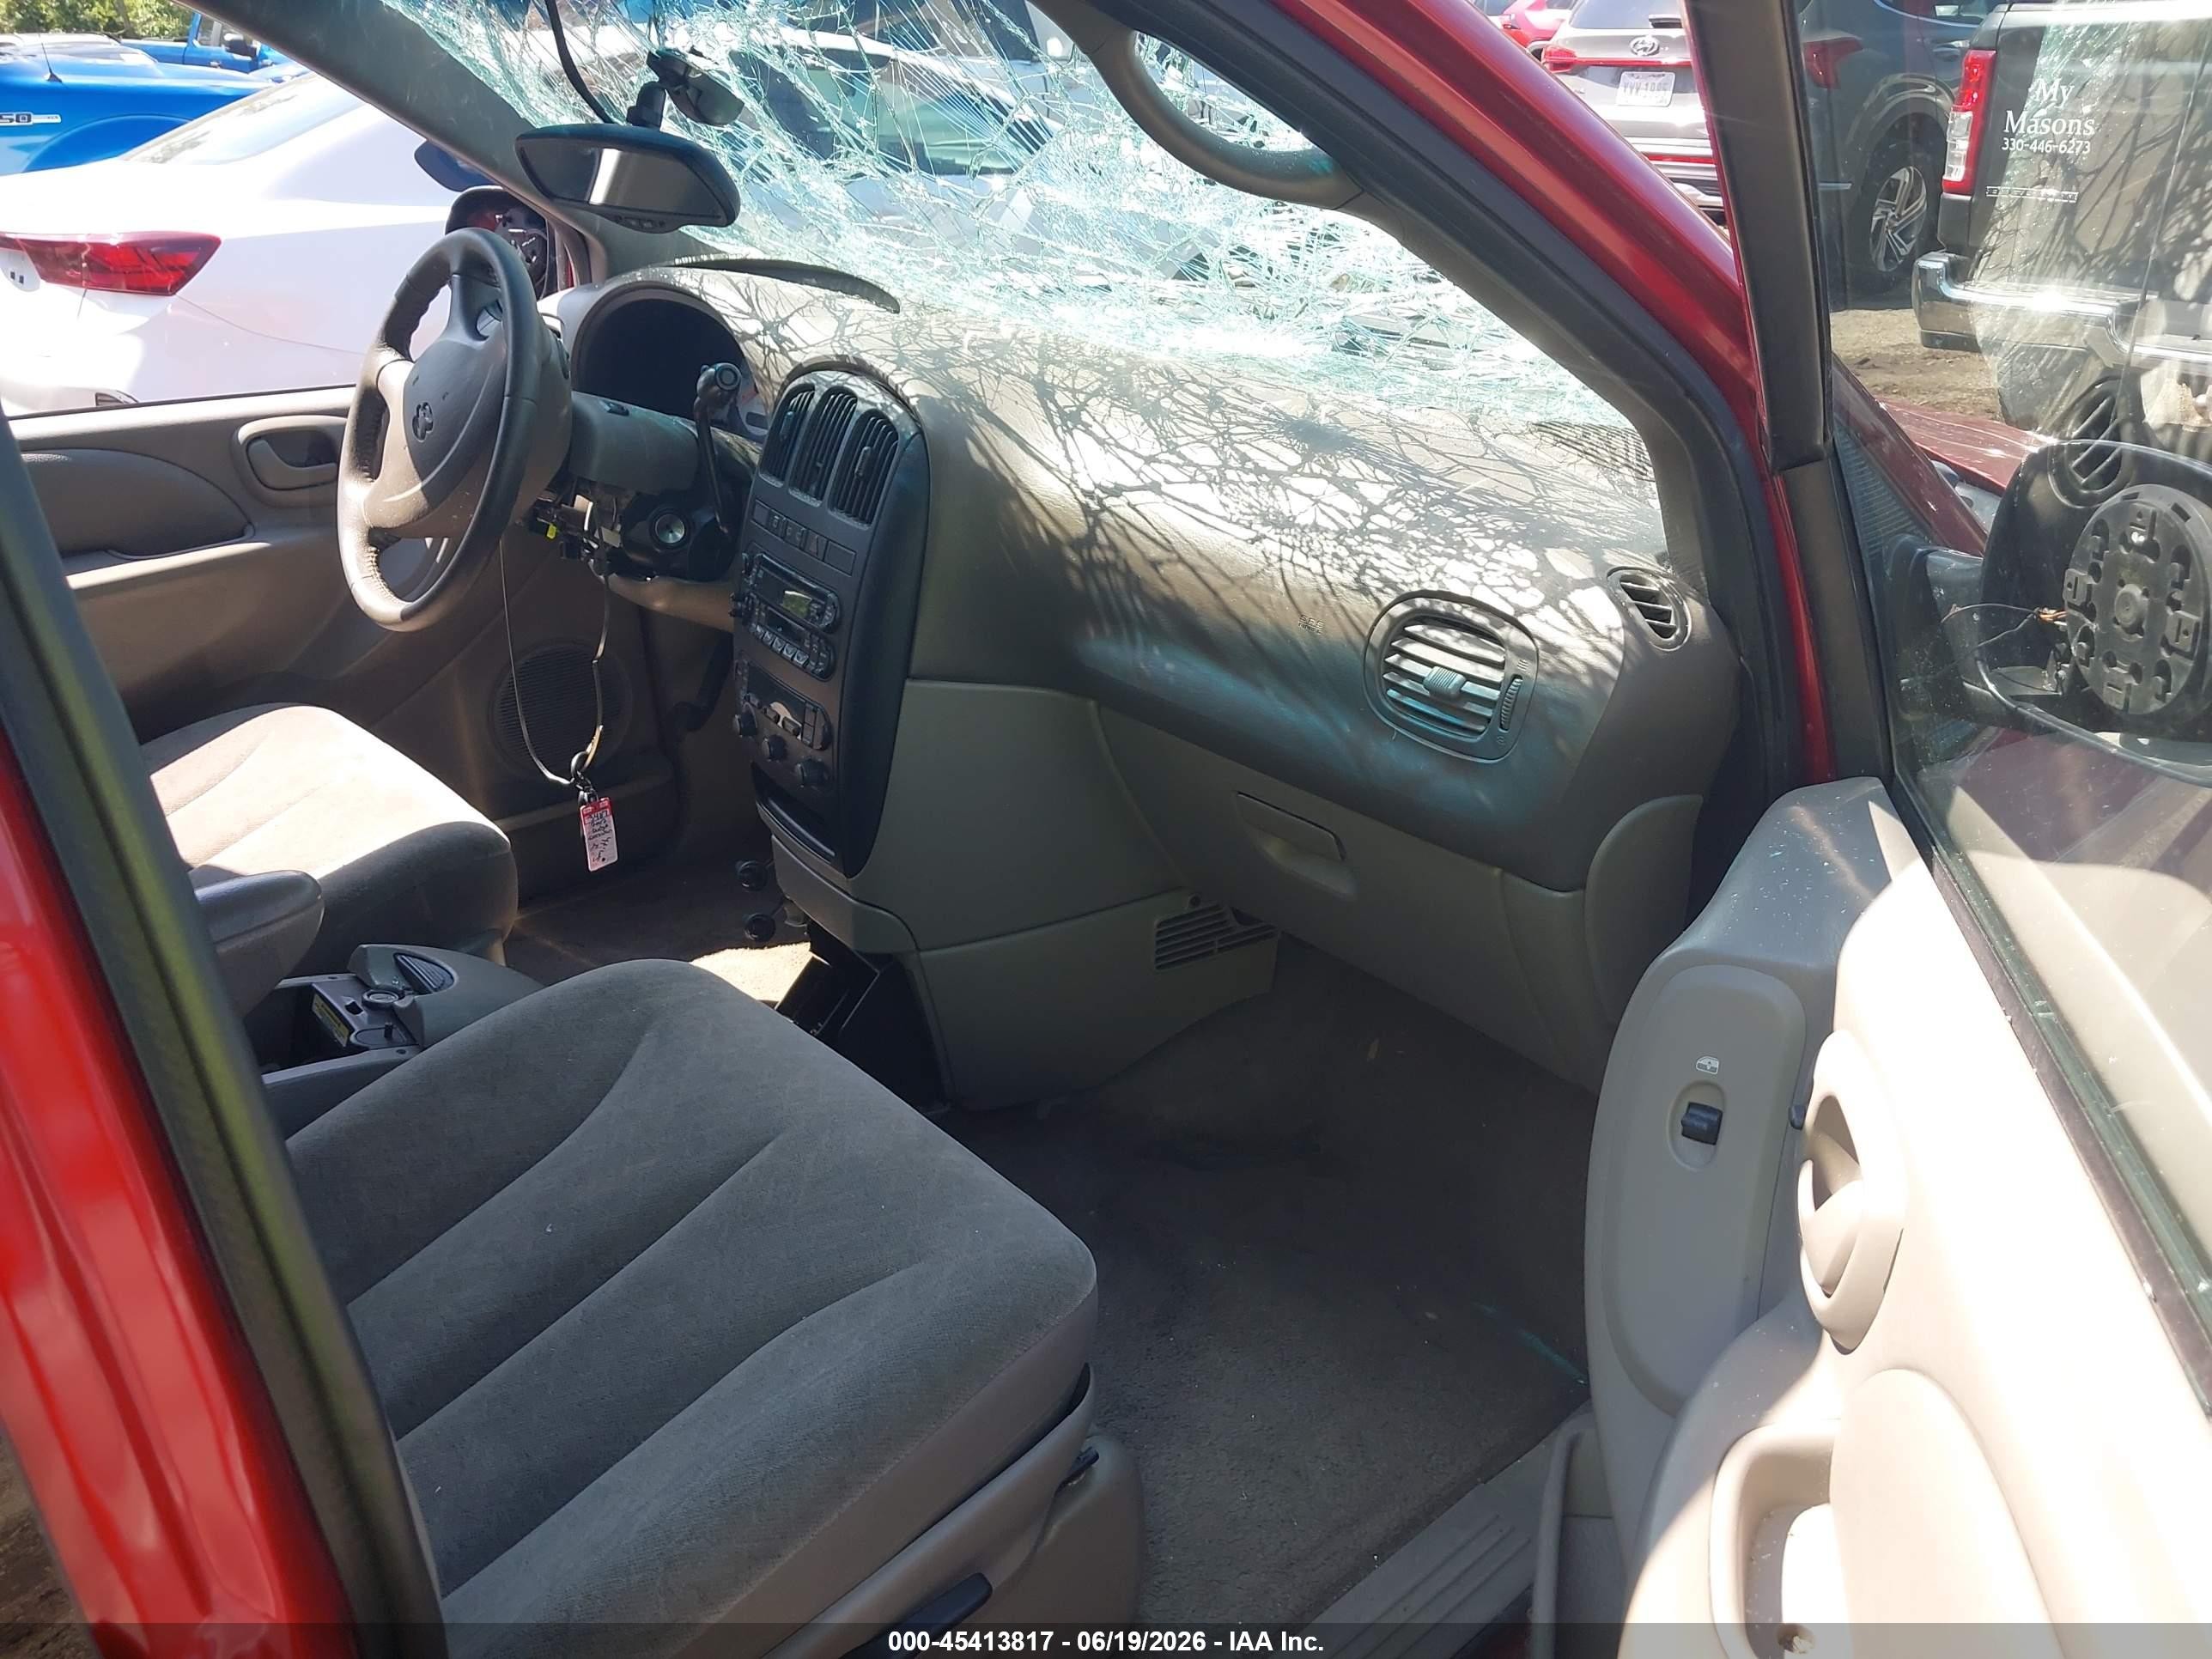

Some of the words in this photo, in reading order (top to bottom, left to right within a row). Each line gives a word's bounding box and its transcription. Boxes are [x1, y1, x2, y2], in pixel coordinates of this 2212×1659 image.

[2034, 78, 2075, 108] My
[2002, 110, 2095, 136] Masons
[2002, 137, 2091, 155] 330-446-6273
